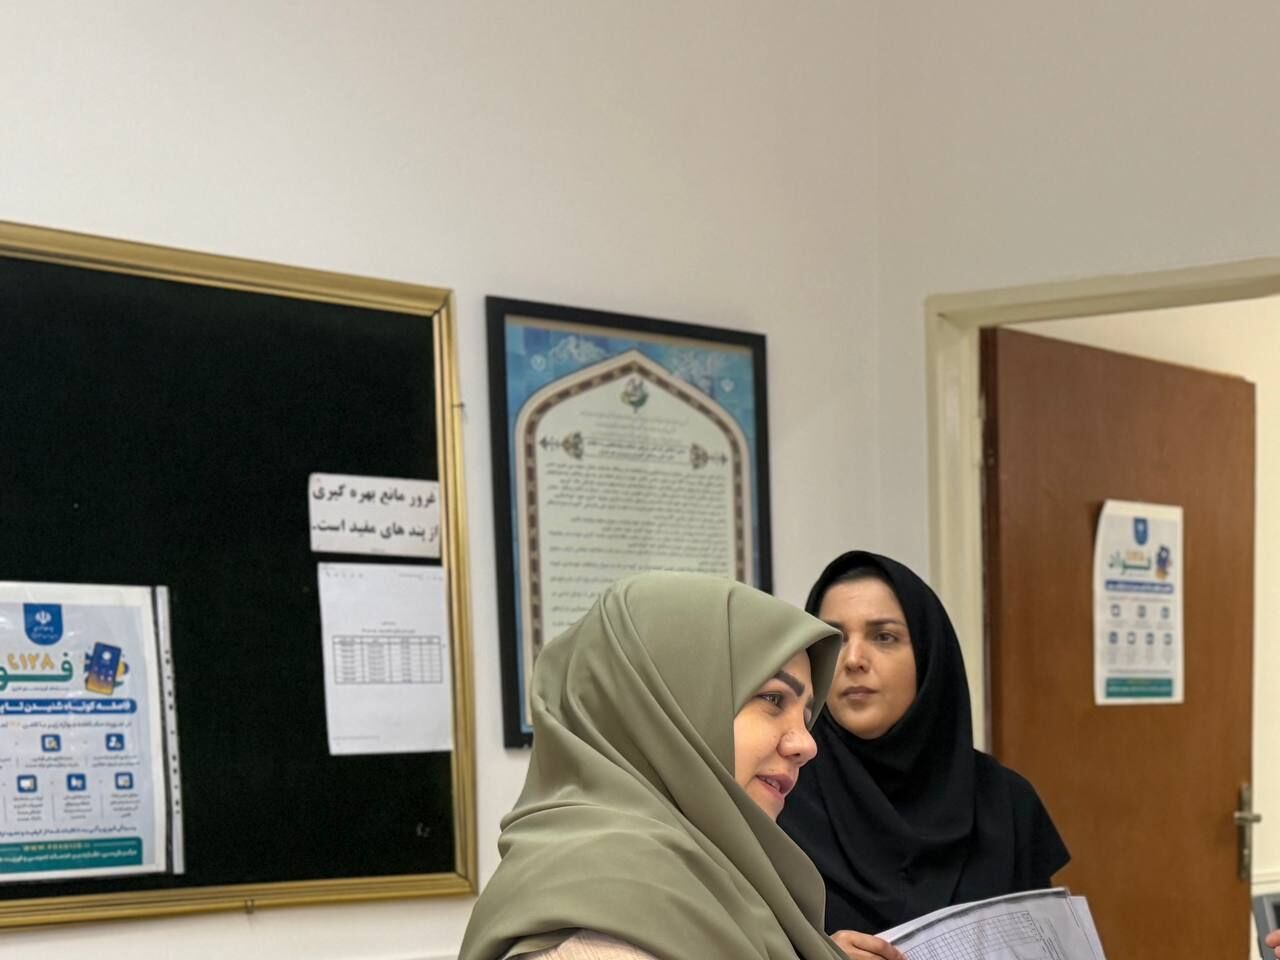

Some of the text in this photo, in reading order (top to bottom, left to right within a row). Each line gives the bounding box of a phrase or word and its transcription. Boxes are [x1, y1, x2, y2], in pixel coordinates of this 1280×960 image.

[350, 488, 376, 503] بهره
[380, 487, 405, 505] مانع
[409, 491, 436, 508] غرور
[349, 519, 376, 537] مفید
[380, 522, 405, 539] های
[408, 525, 425, 541] پند
